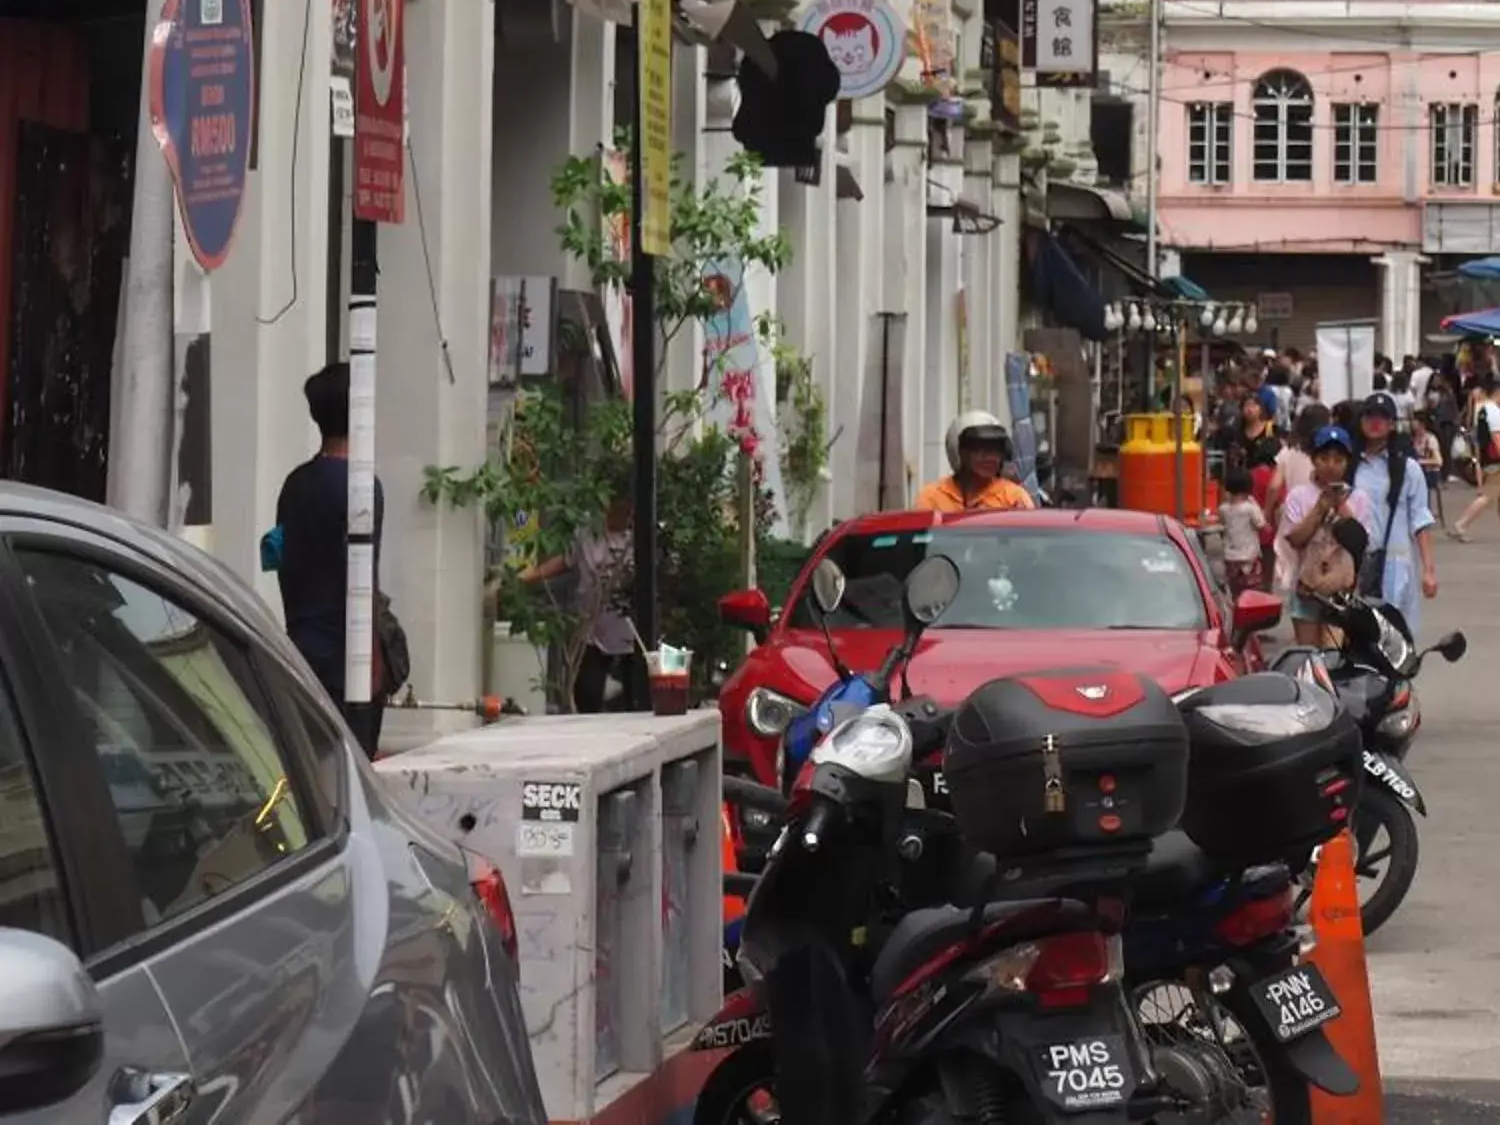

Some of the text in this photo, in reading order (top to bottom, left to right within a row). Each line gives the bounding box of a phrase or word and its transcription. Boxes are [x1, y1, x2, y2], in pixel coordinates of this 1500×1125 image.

[524, 784, 580, 809] SECK
[1268, 971, 1311, 1006] PNN
[1281, 990, 1325, 1024] 4146
[1049, 1041, 1110, 1069] PMS
[1048, 1064, 1125, 1093] 7045
